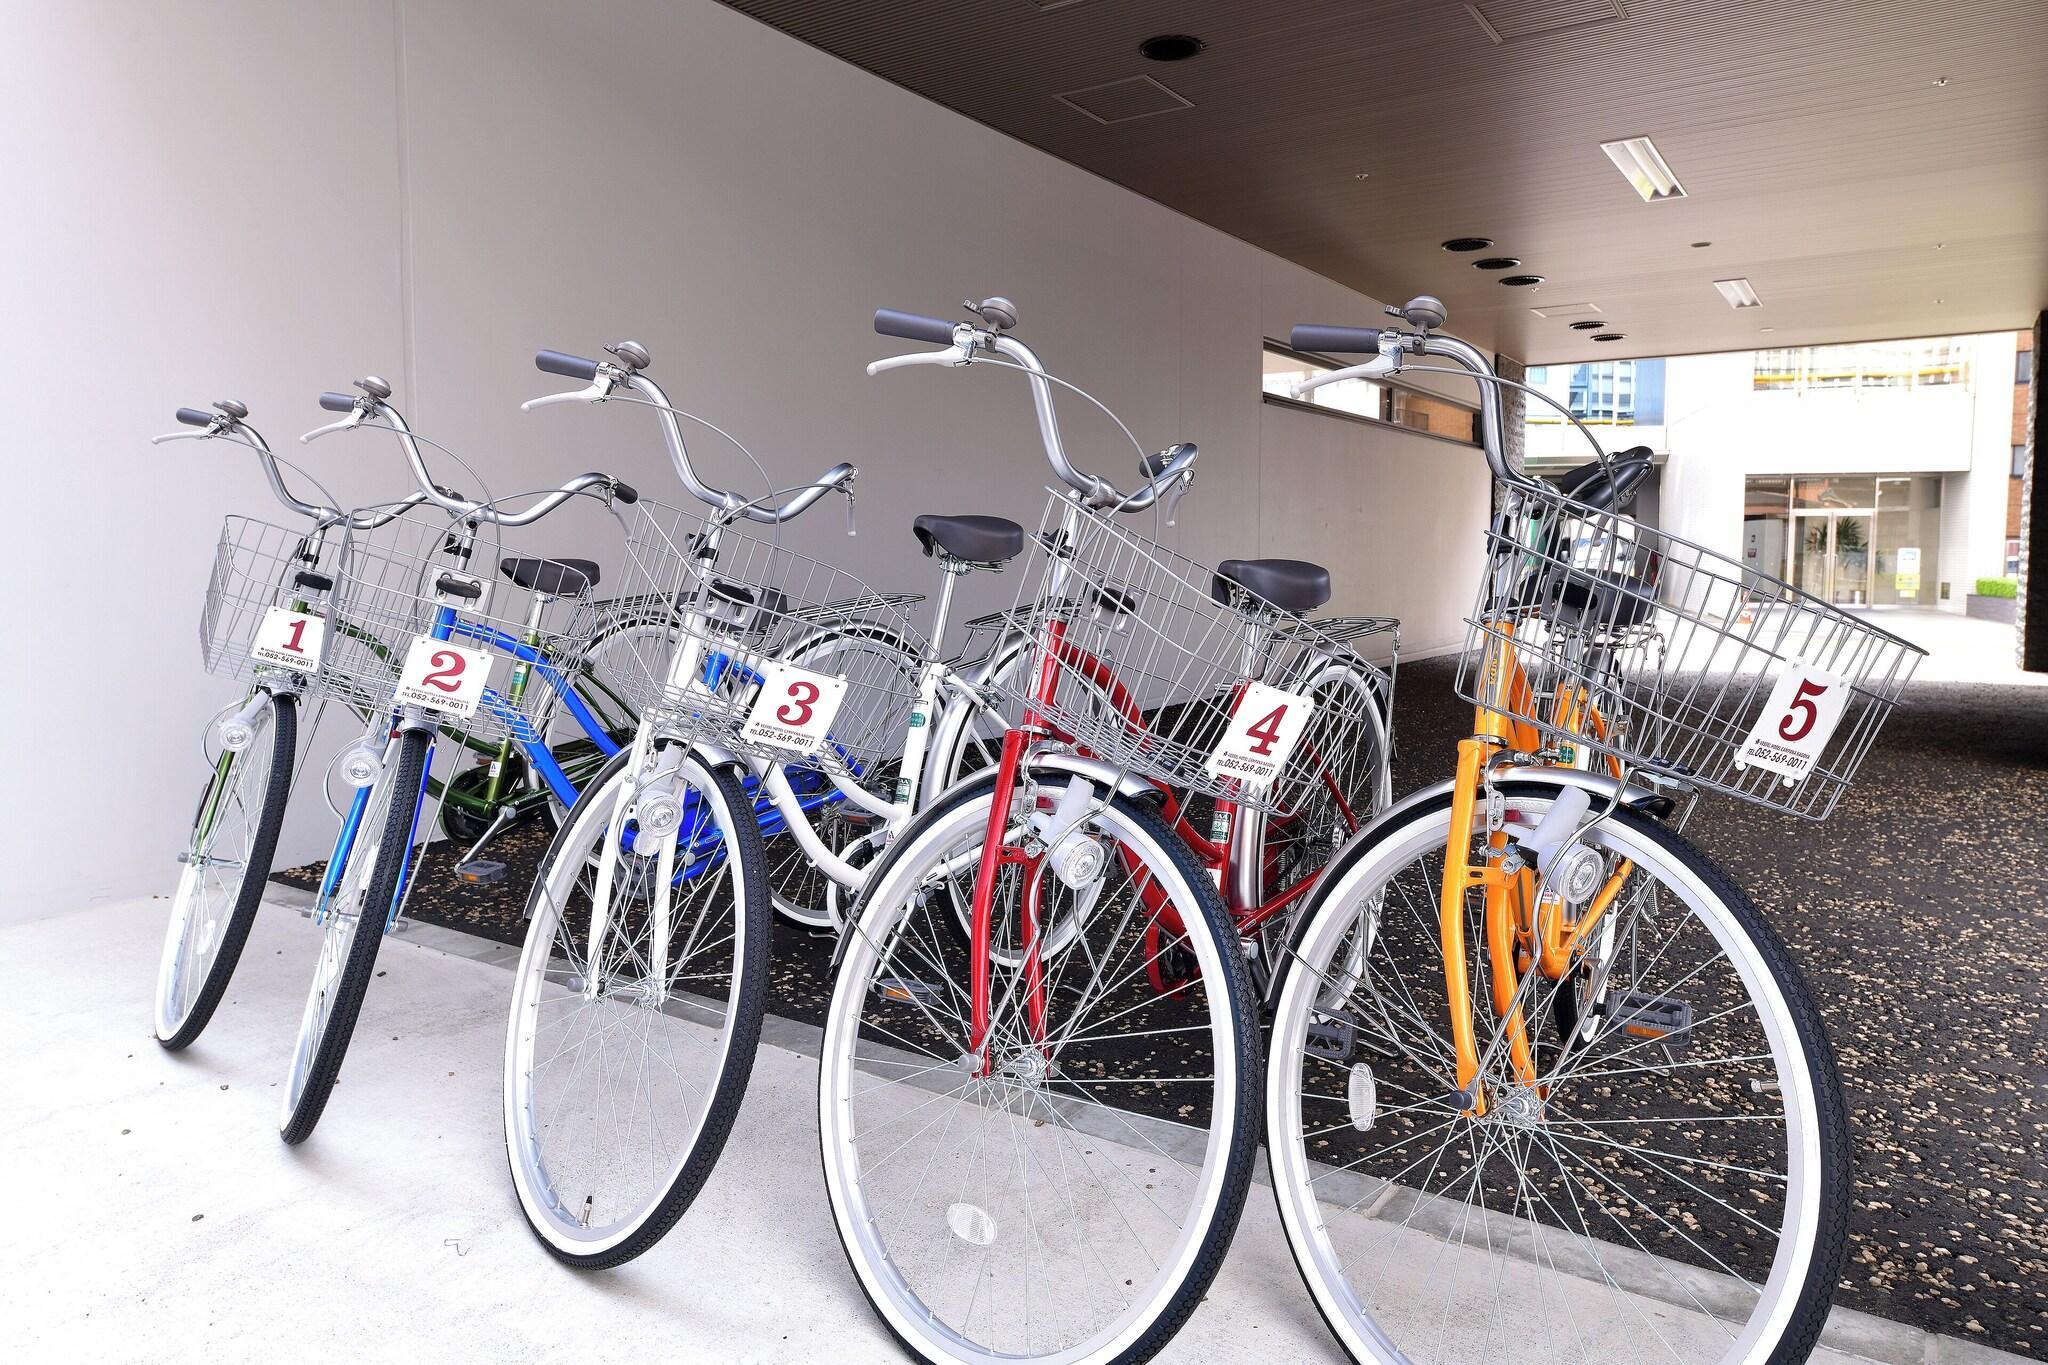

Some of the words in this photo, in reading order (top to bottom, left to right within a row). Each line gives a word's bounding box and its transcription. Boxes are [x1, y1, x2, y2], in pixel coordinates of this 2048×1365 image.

[282, 619, 306, 653] 1
[422, 650, 466, 692] 2
[776, 681, 819, 725] 3
[1779, 677, 1828, 741] 5
[1246, 704, 1288, 756] 4
